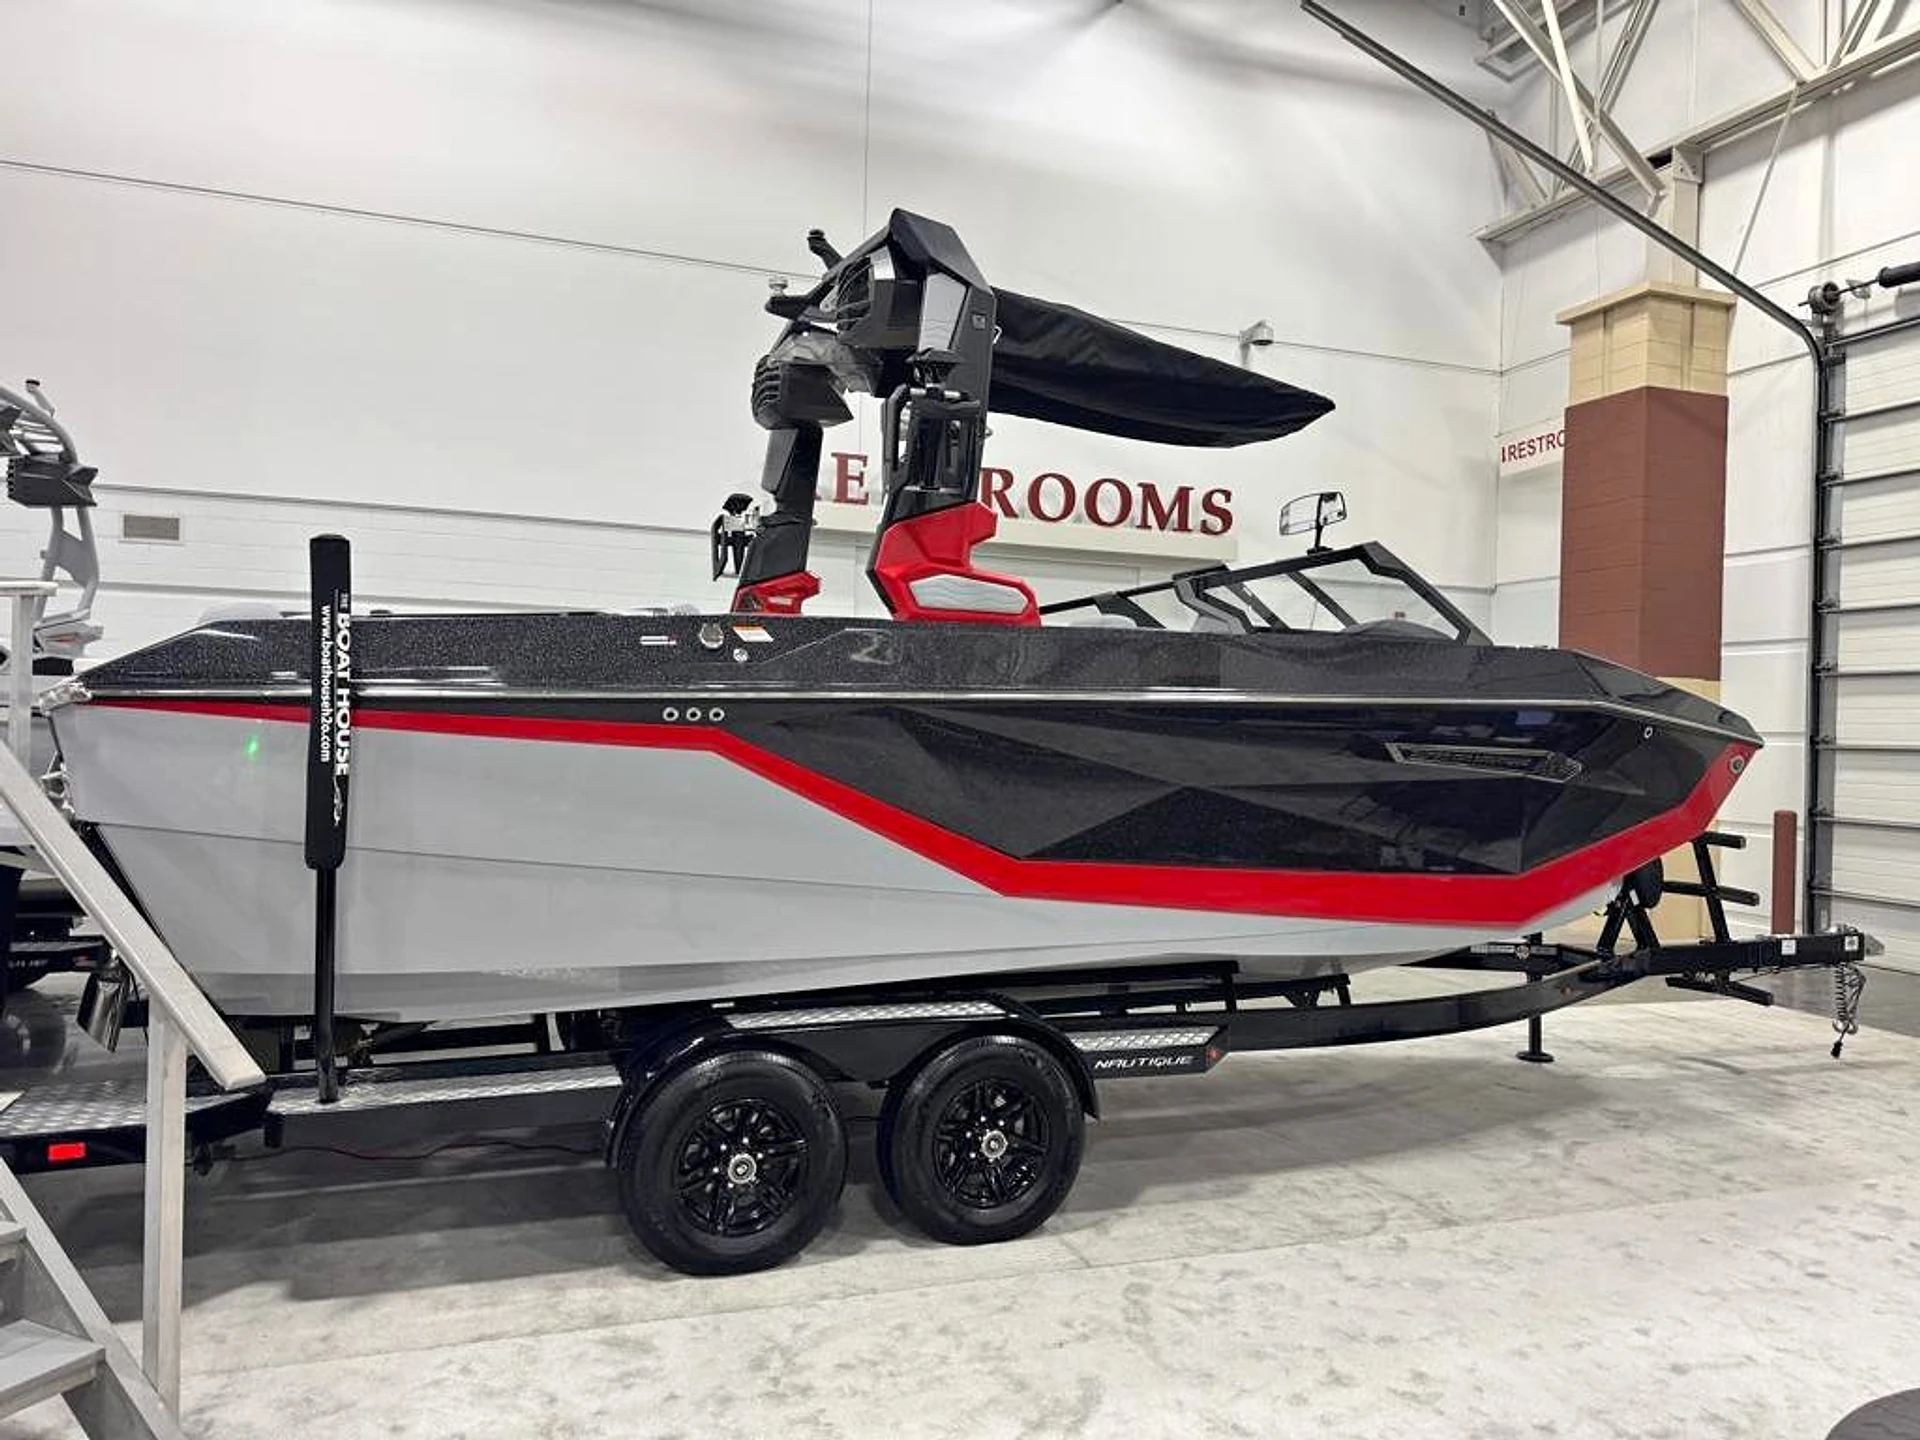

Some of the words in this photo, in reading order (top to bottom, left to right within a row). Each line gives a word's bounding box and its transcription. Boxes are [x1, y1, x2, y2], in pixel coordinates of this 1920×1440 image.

[814, 452, 1234, 536] EROOMS
[320, 605, 333, 763] www.boathouseh2o.com
[337, 612, 351, 682] BOAT
[336, 688, 351, 776] HOUSE
[1095, 1055, 1195, 1068] NAUTIQUE
